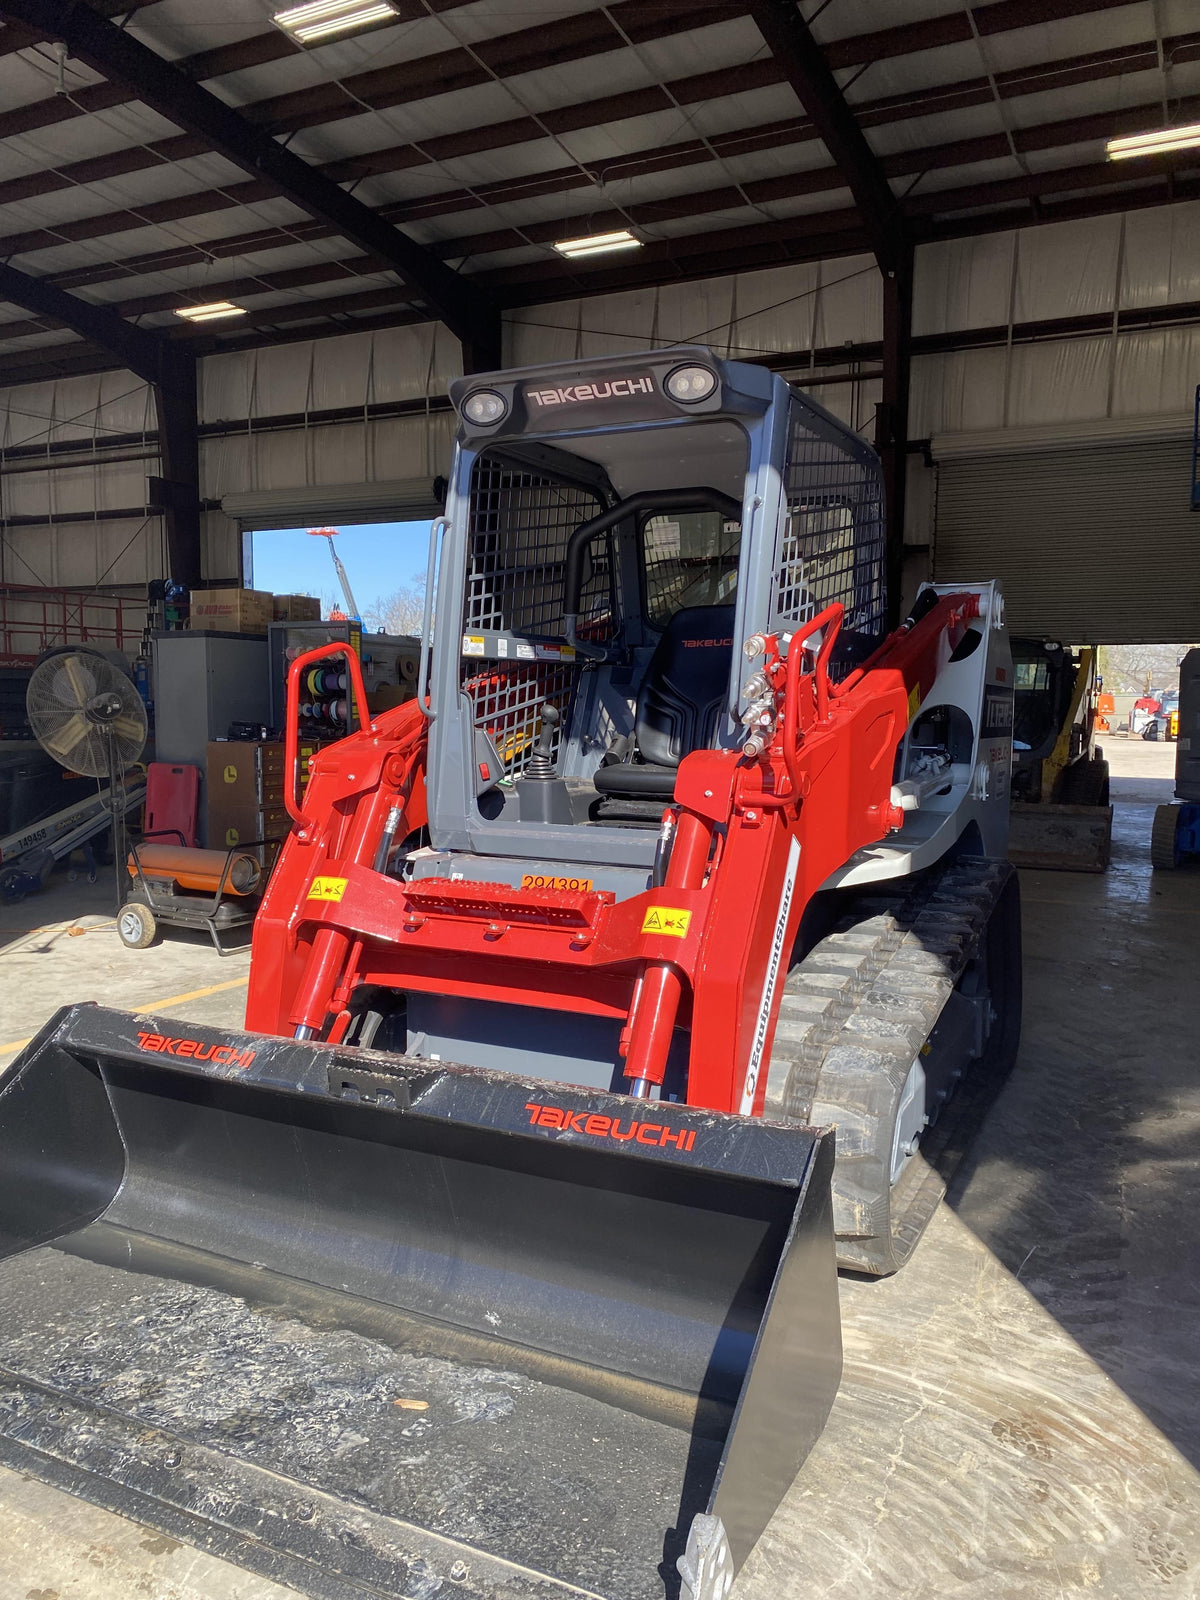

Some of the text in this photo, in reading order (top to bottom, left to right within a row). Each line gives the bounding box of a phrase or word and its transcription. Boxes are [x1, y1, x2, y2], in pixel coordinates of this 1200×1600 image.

[527, 377, 654, 406] TAKEUCHI
[682, 638, 734, 648] TAKEUC
[17, 828, 47, 849] 149458
[524, 875, 589, 891] 294391
[750, 878, 793, 1071] EquipmentShare
[136, 1031, 256, 1069] TAKEUCHI
[523, 1103, 697, 1152] TAKEUCHI
